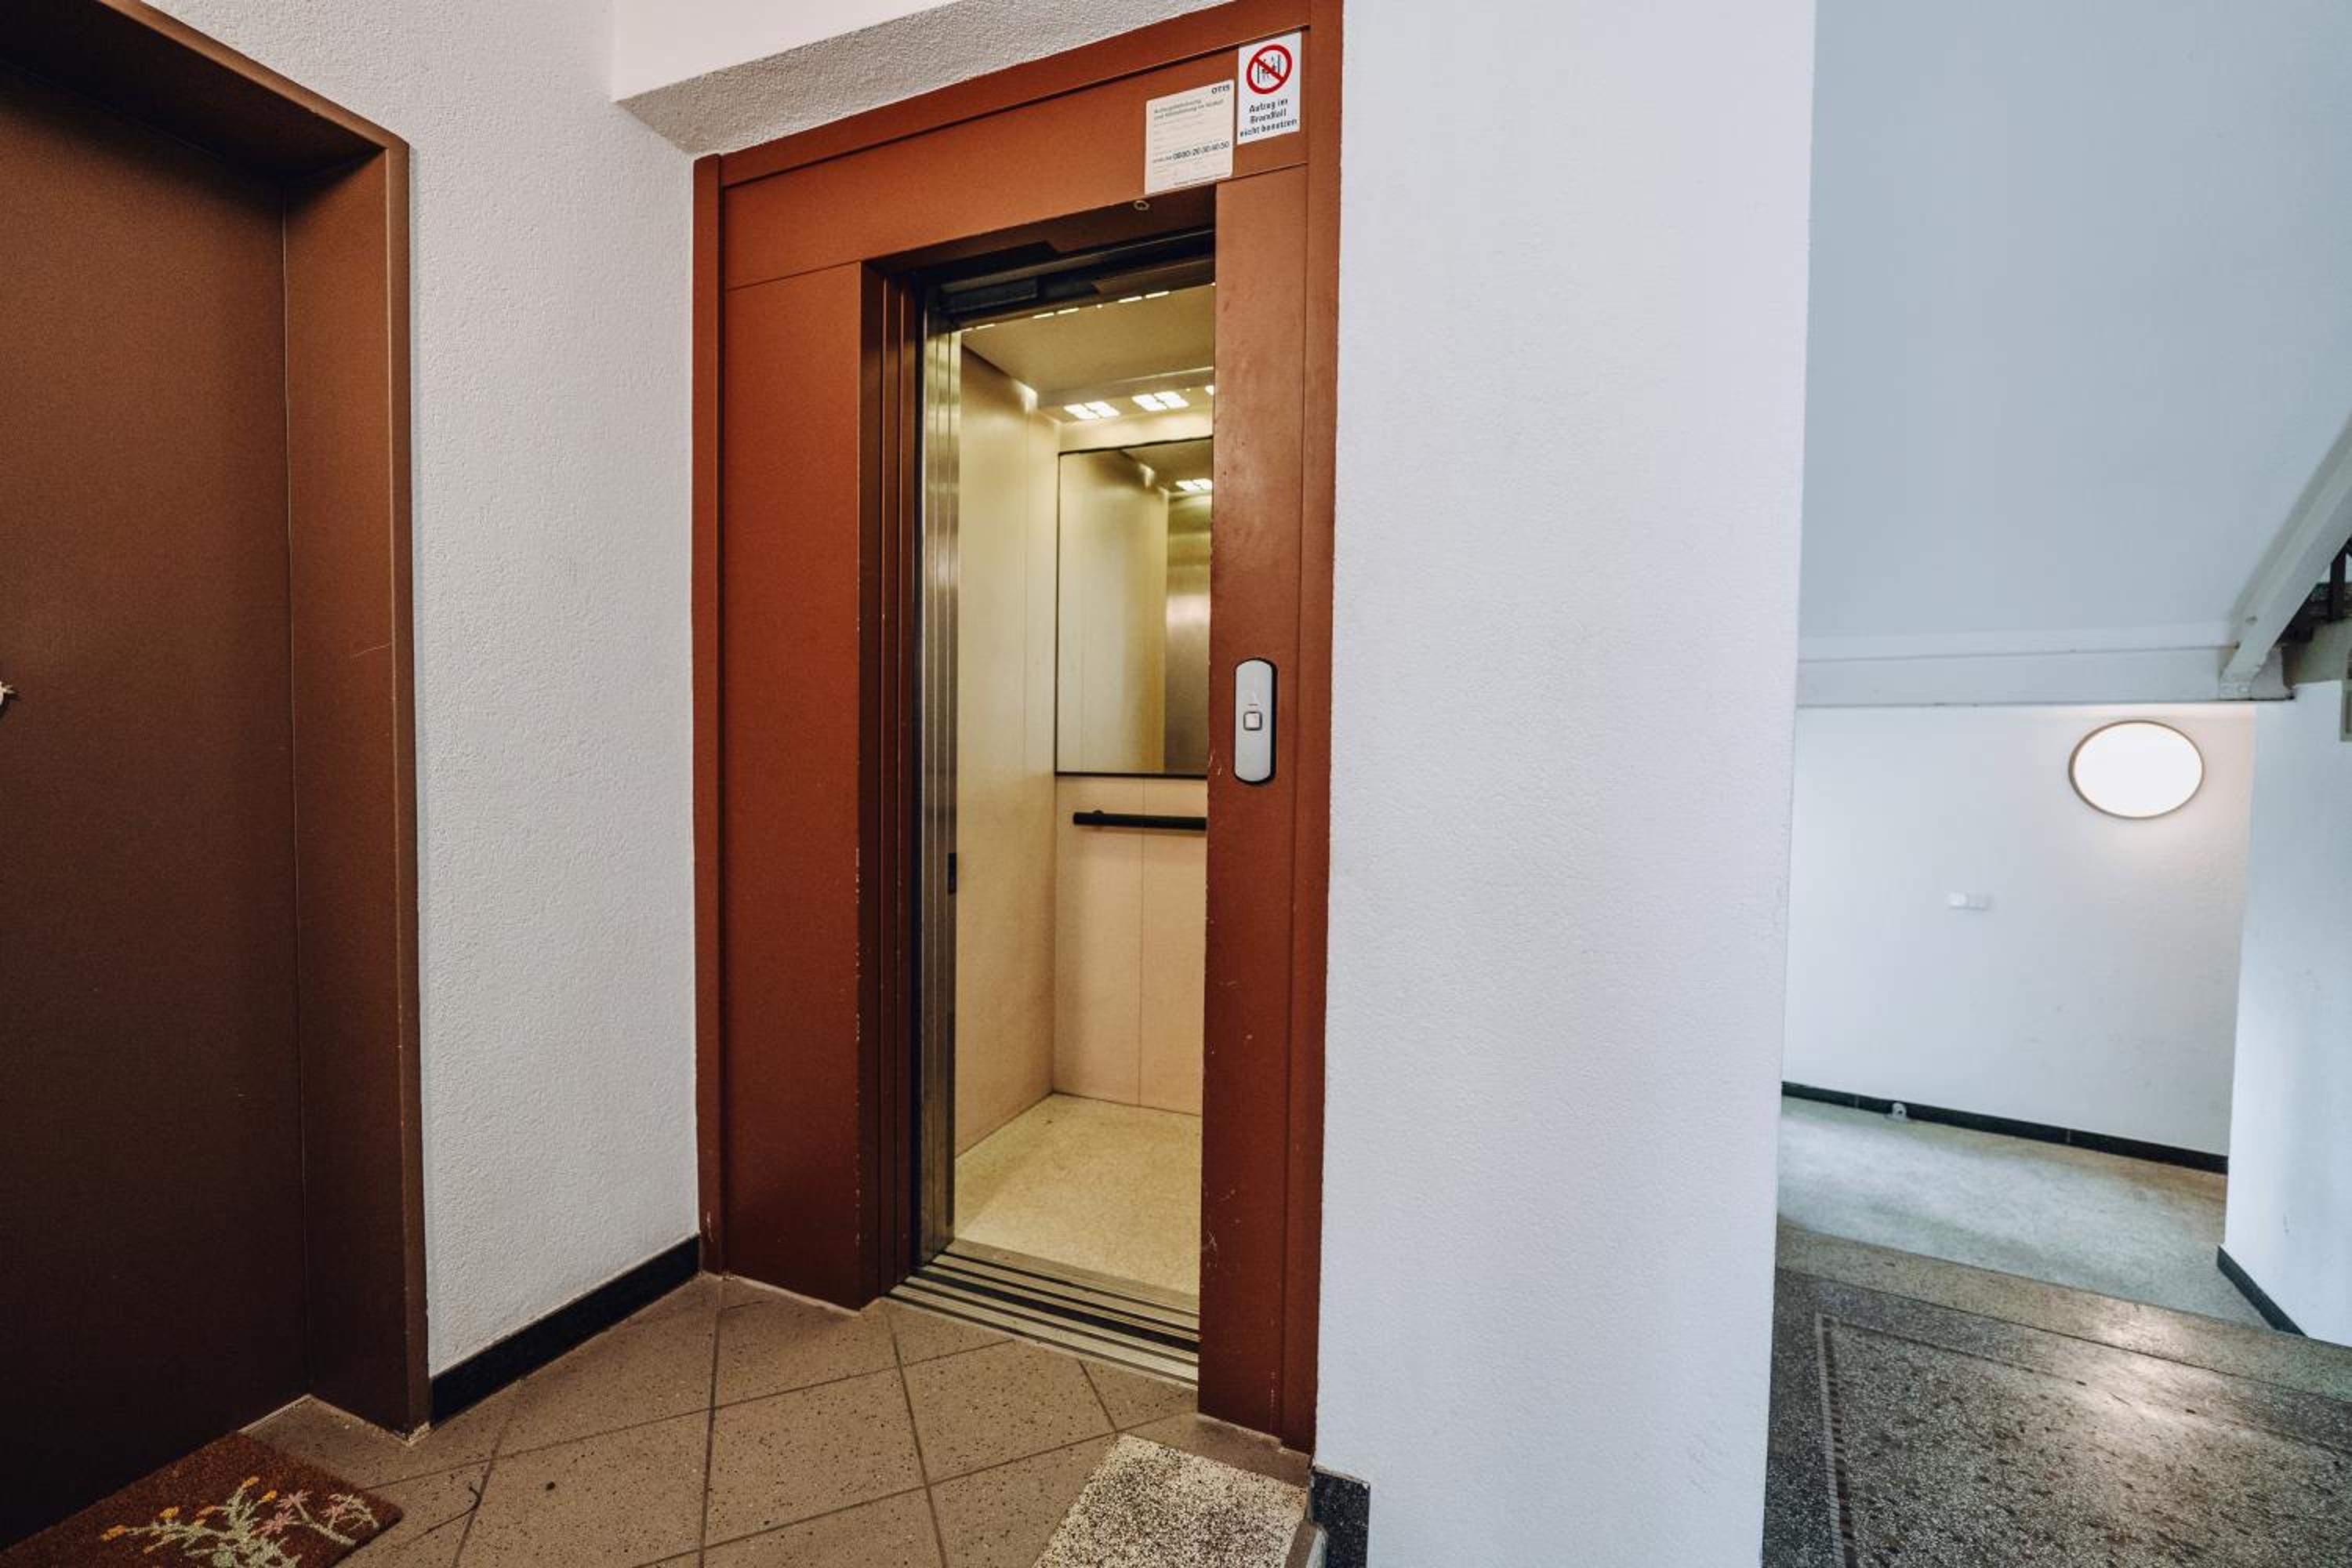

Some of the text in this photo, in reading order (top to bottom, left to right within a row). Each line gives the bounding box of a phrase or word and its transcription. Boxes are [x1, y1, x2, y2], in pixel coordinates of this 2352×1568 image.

[1211, 84, 1230, 94] OTIS
[1249, 98, 1289, 114] Aufzug im
[1250, 107, 1287, 125] Brandfall
[1240, 118, 1298, 138] nicht benutzen
